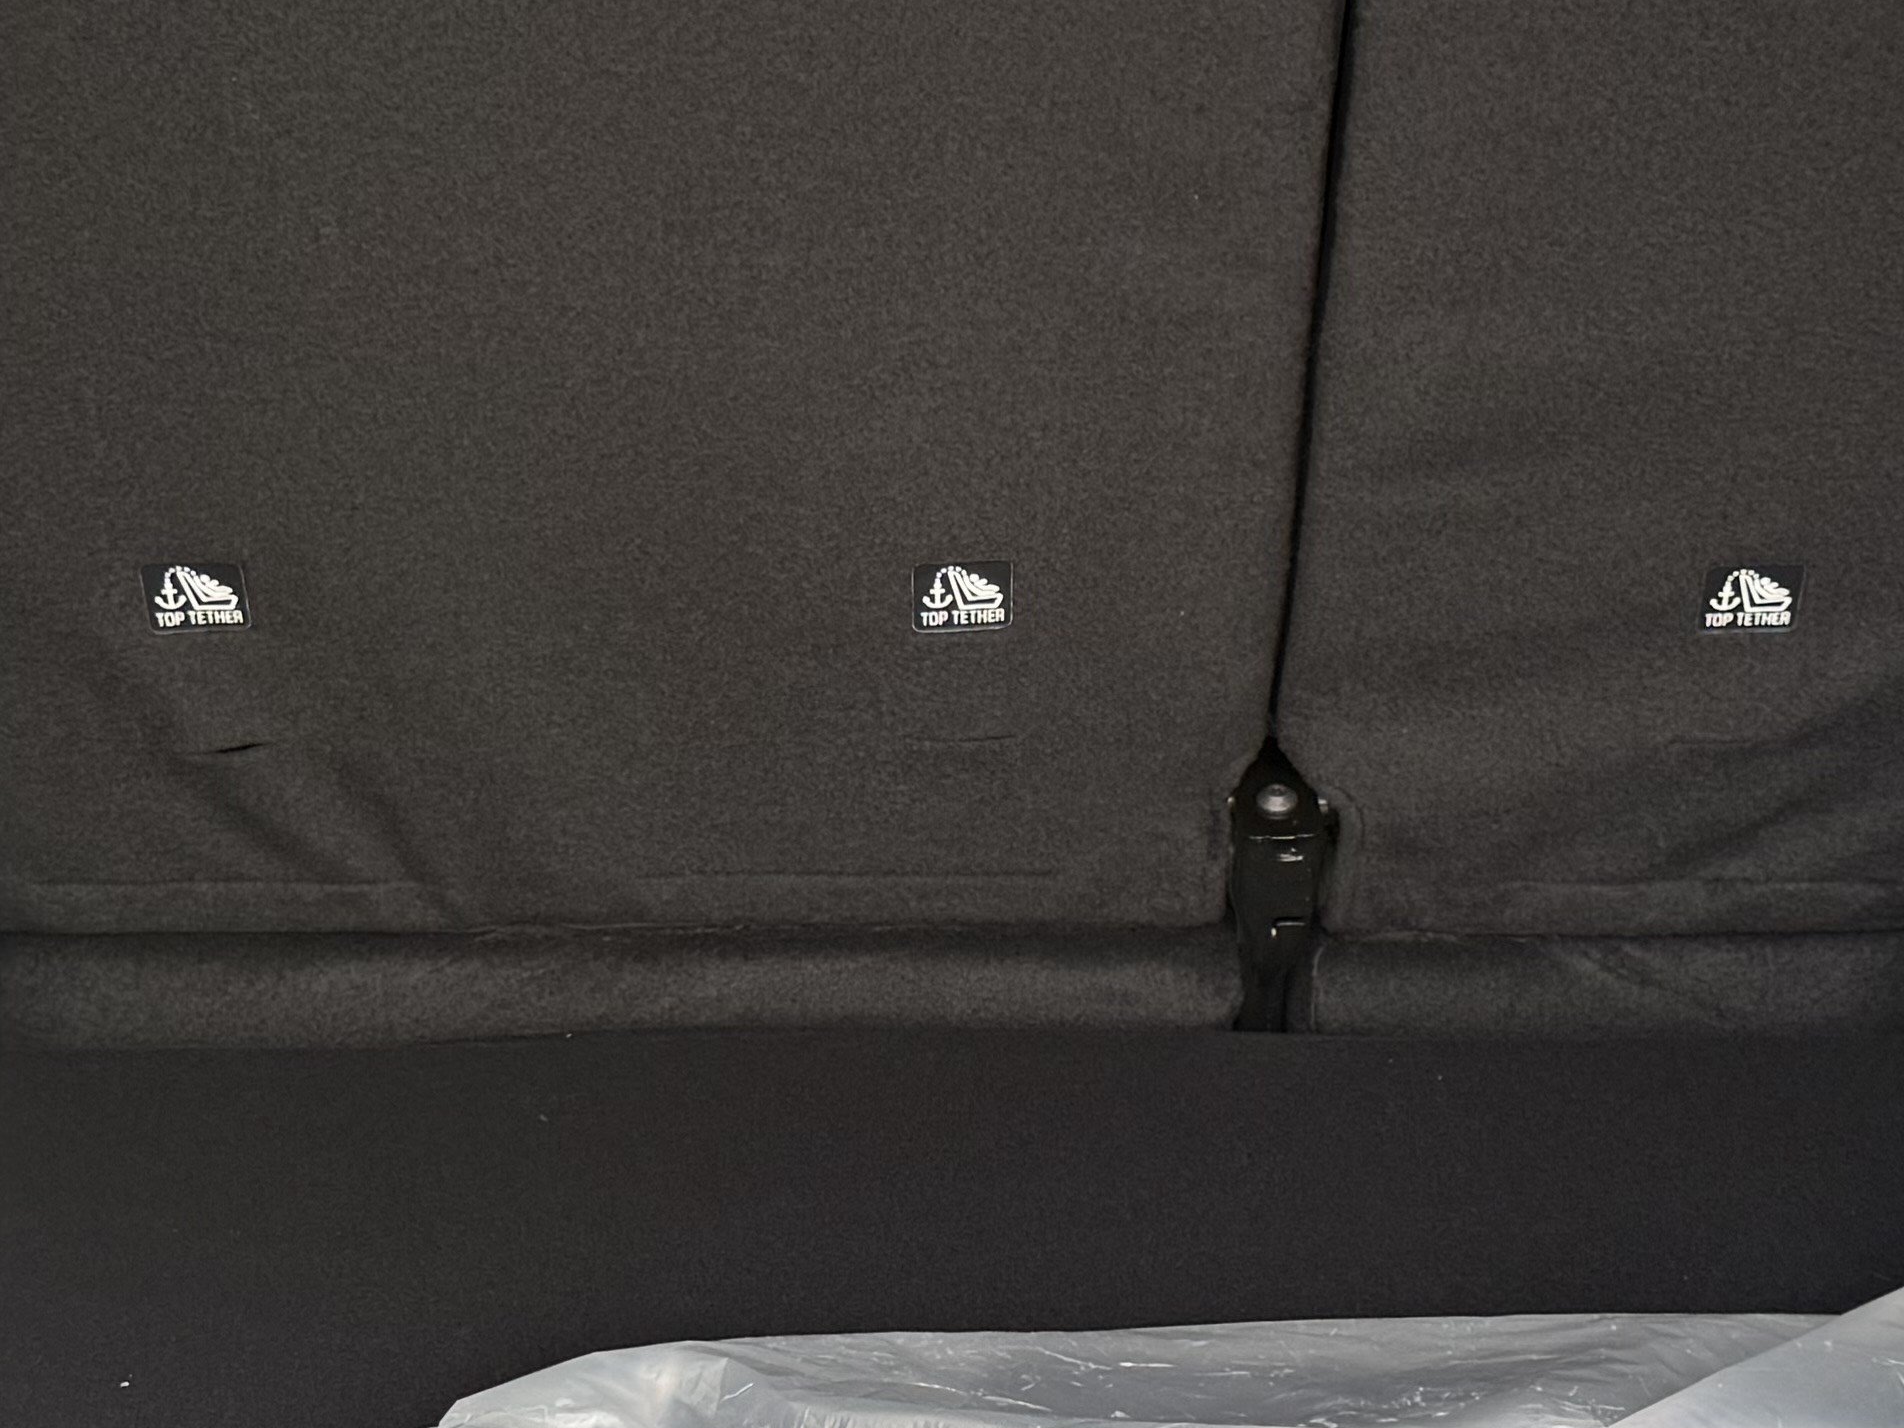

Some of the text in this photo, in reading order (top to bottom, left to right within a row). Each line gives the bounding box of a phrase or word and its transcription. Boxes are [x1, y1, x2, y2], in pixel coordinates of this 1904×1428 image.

[155, 610, 244, 627] TOP TETHER
[920, 608, 1005, 627] TOP TETHER
[1705, 611, 1792, 627] TOP TETHER
